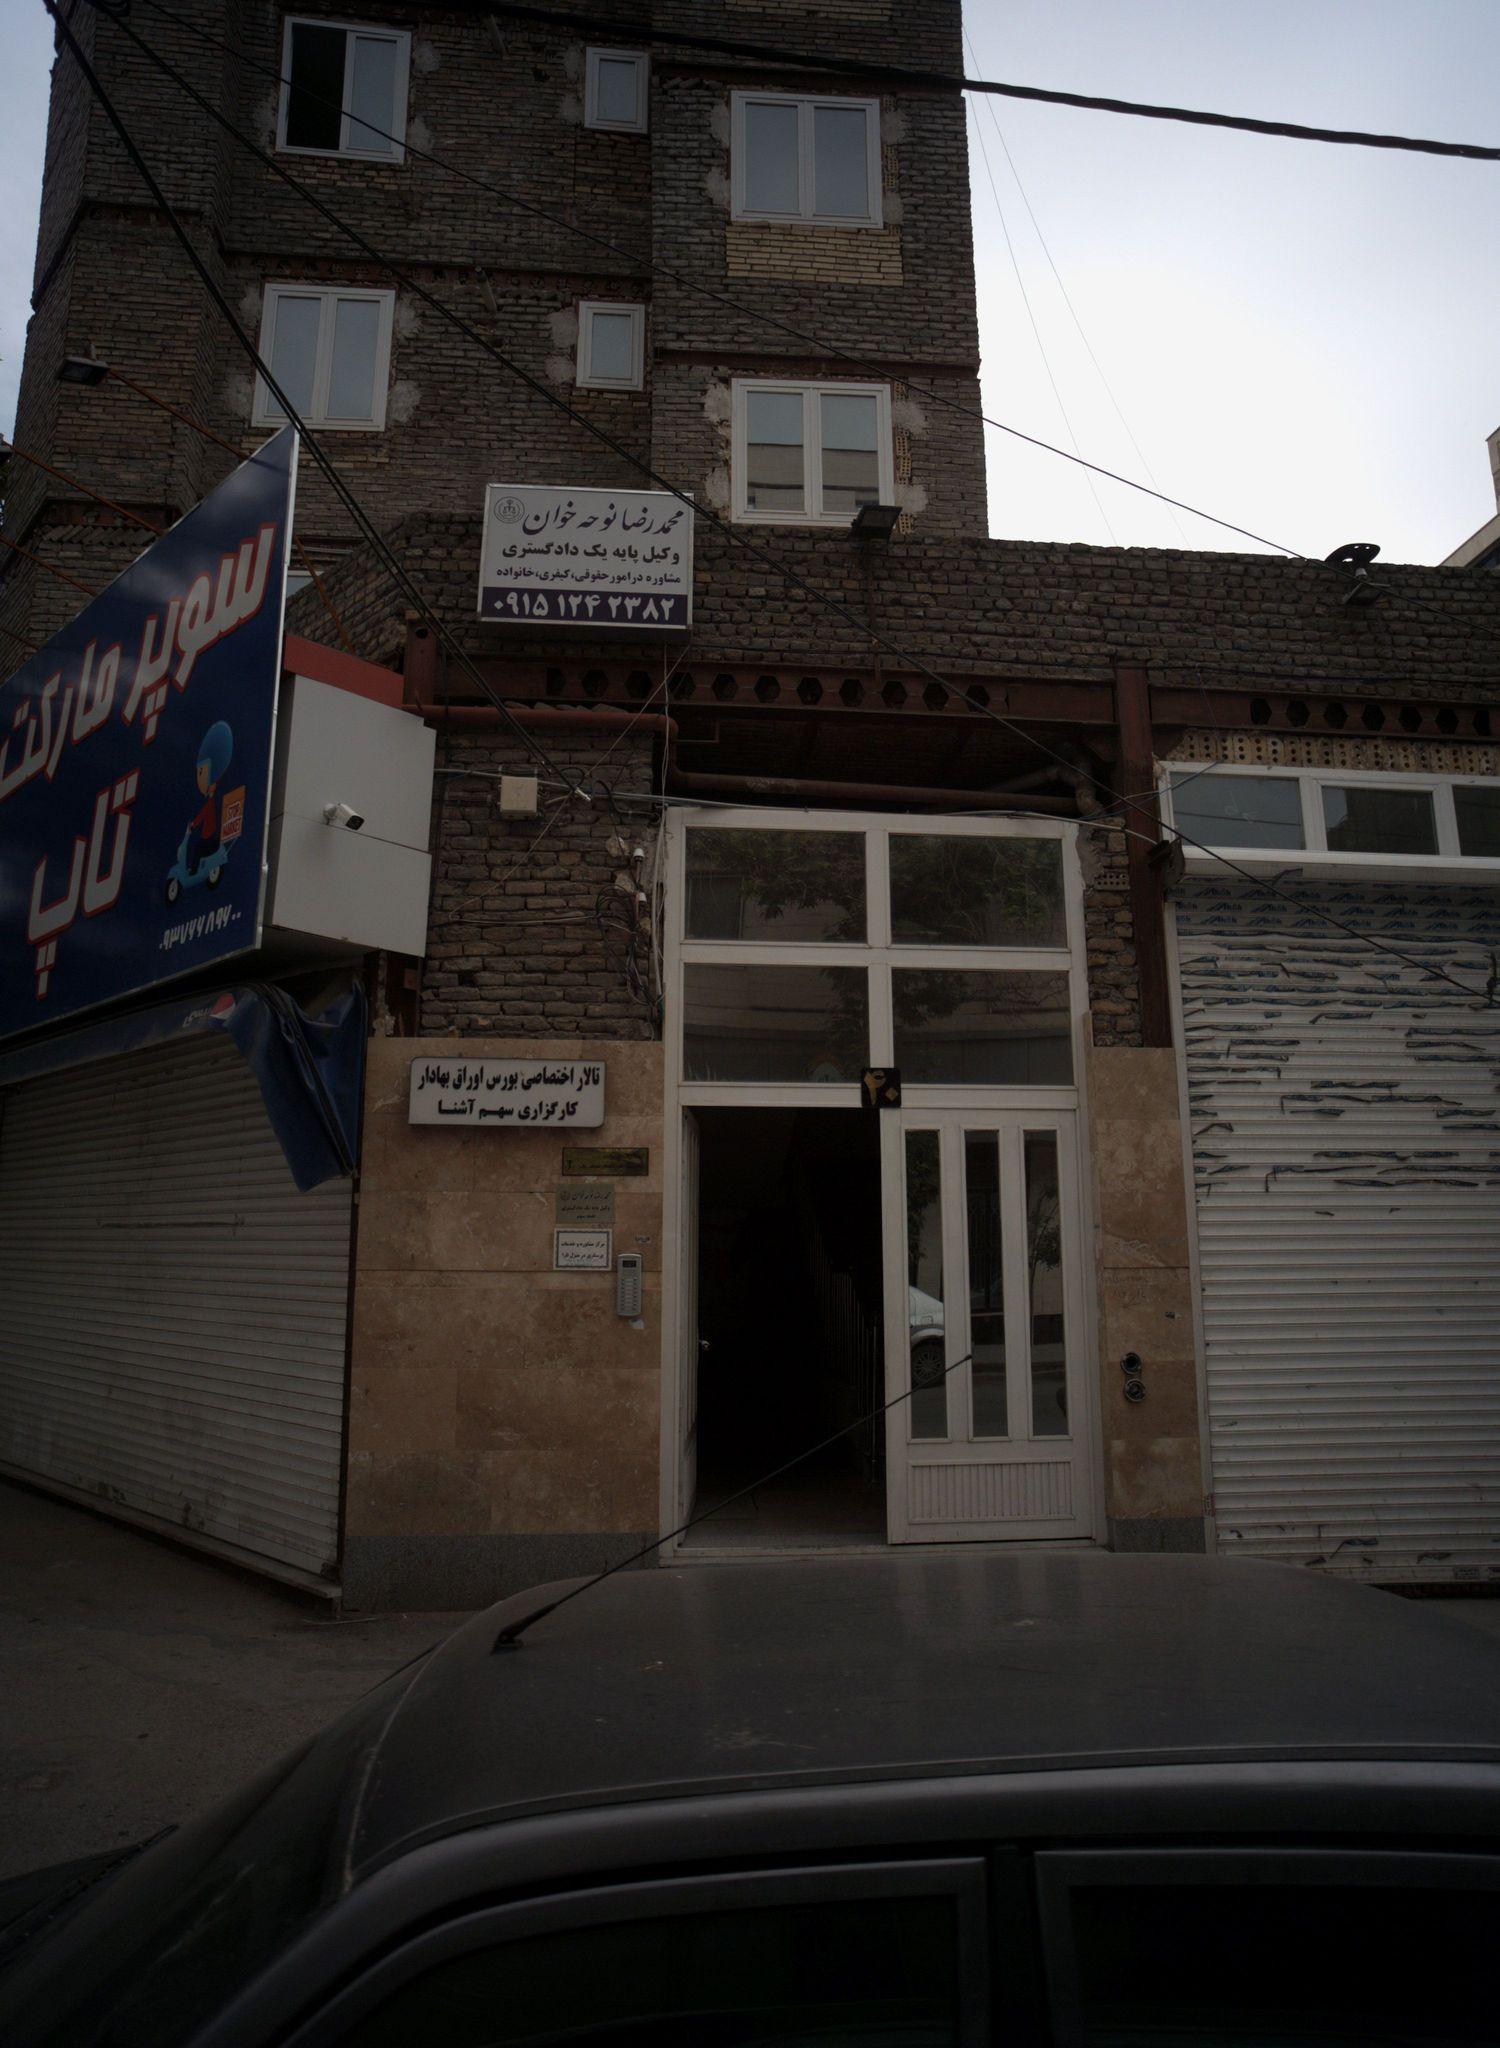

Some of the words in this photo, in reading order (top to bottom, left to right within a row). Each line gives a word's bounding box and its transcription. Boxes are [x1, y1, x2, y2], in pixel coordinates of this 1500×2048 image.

[502, 542, 579, 558] دادگستری
[583, 543, 607, 561] یک
[612, 544, 638, 563] پایه
[643, 545, 680, 565] وکیل
[646, 572, 681, 586] مشاوره
[494, 591, 549, 616] ۰۹۱۵
[557, 593, 601, 618] ۱۲۴
[607, 595, 675, 621] ۲۳۸۲
[120, 519, 277, 746] سوپر
[26, 768, 140, 1003] تاپ
[417, 1065, 450, 1090] بهادار
[452, 1066, 484, 1091] اوراق
[486, 1071, 518, 1091] بورس
[521, 1066, 574, 1090] اختصاصی
[576, 1066, 600, 1091] تالار
[438, 1098, 476, 1115] آشنا
[479, 1105, 514, 1119] سهم
[518, 1100, 578, 1121] کارگزاری
